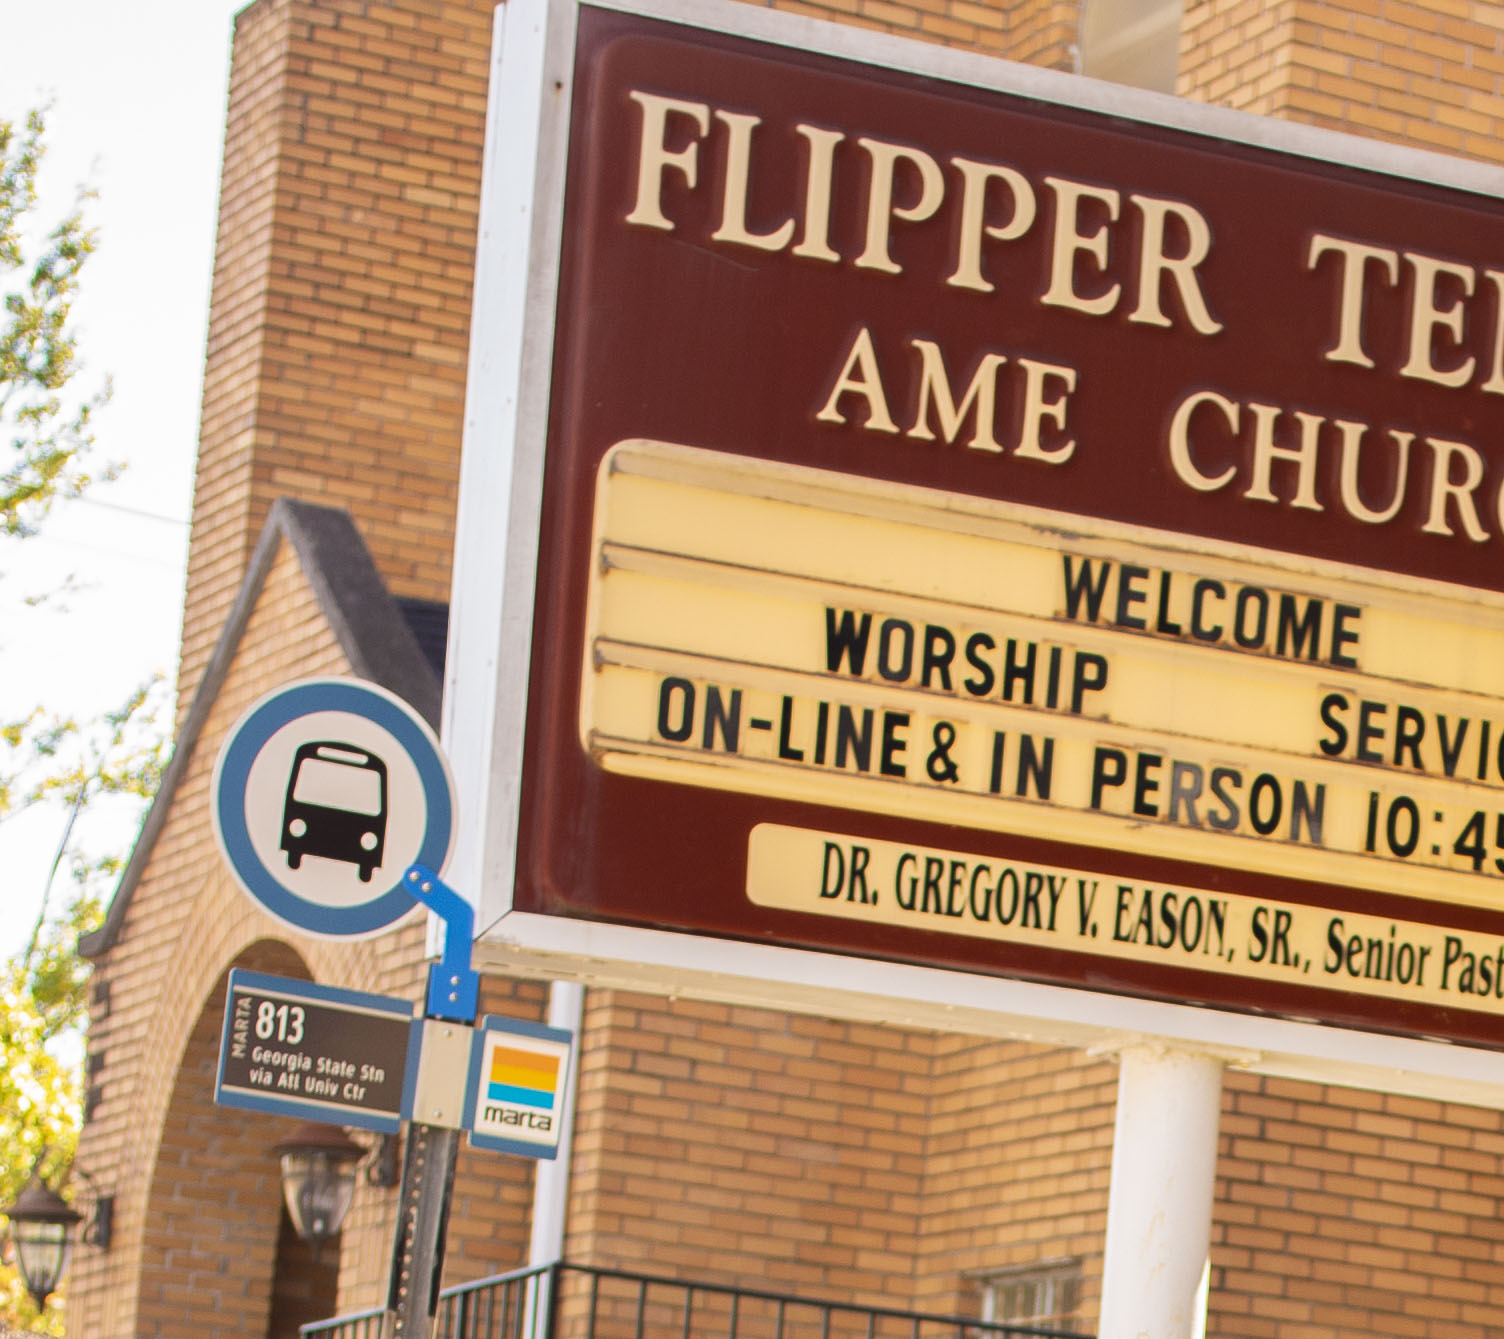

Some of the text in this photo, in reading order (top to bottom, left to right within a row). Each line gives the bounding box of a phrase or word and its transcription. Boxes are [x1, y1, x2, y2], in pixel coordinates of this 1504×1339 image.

[624, 90, 1224, 336] FLIPPER
[816, 327, 1078, 465] AME
[823, 606, 1110, 715] WORSHIP
[1062, 554, 1363, 670] WELCOME
[990, 730, 1056, 801] IN
[1091, 745, 1327, 847] PERSON
[818, 840, 880, 907] DR.
[894, 851, 1068, 933] GREGORY
[1075, 878, 1101, 939] V.
[1112, 884, 1237, 964] EASON,
[1246, 905, 1312, 975] SR.,
[1323, 916, 1432, 990] Senior
[231, 996, 253, 1060] MARTA
[251, 1045, 386, 1083] Georgia State Stn
[254, 1000, 307, 1046] 813
[249, 1067, 368, 1102] via Atl Univ Ctr
[483, 1103, 553, 1132] marta
